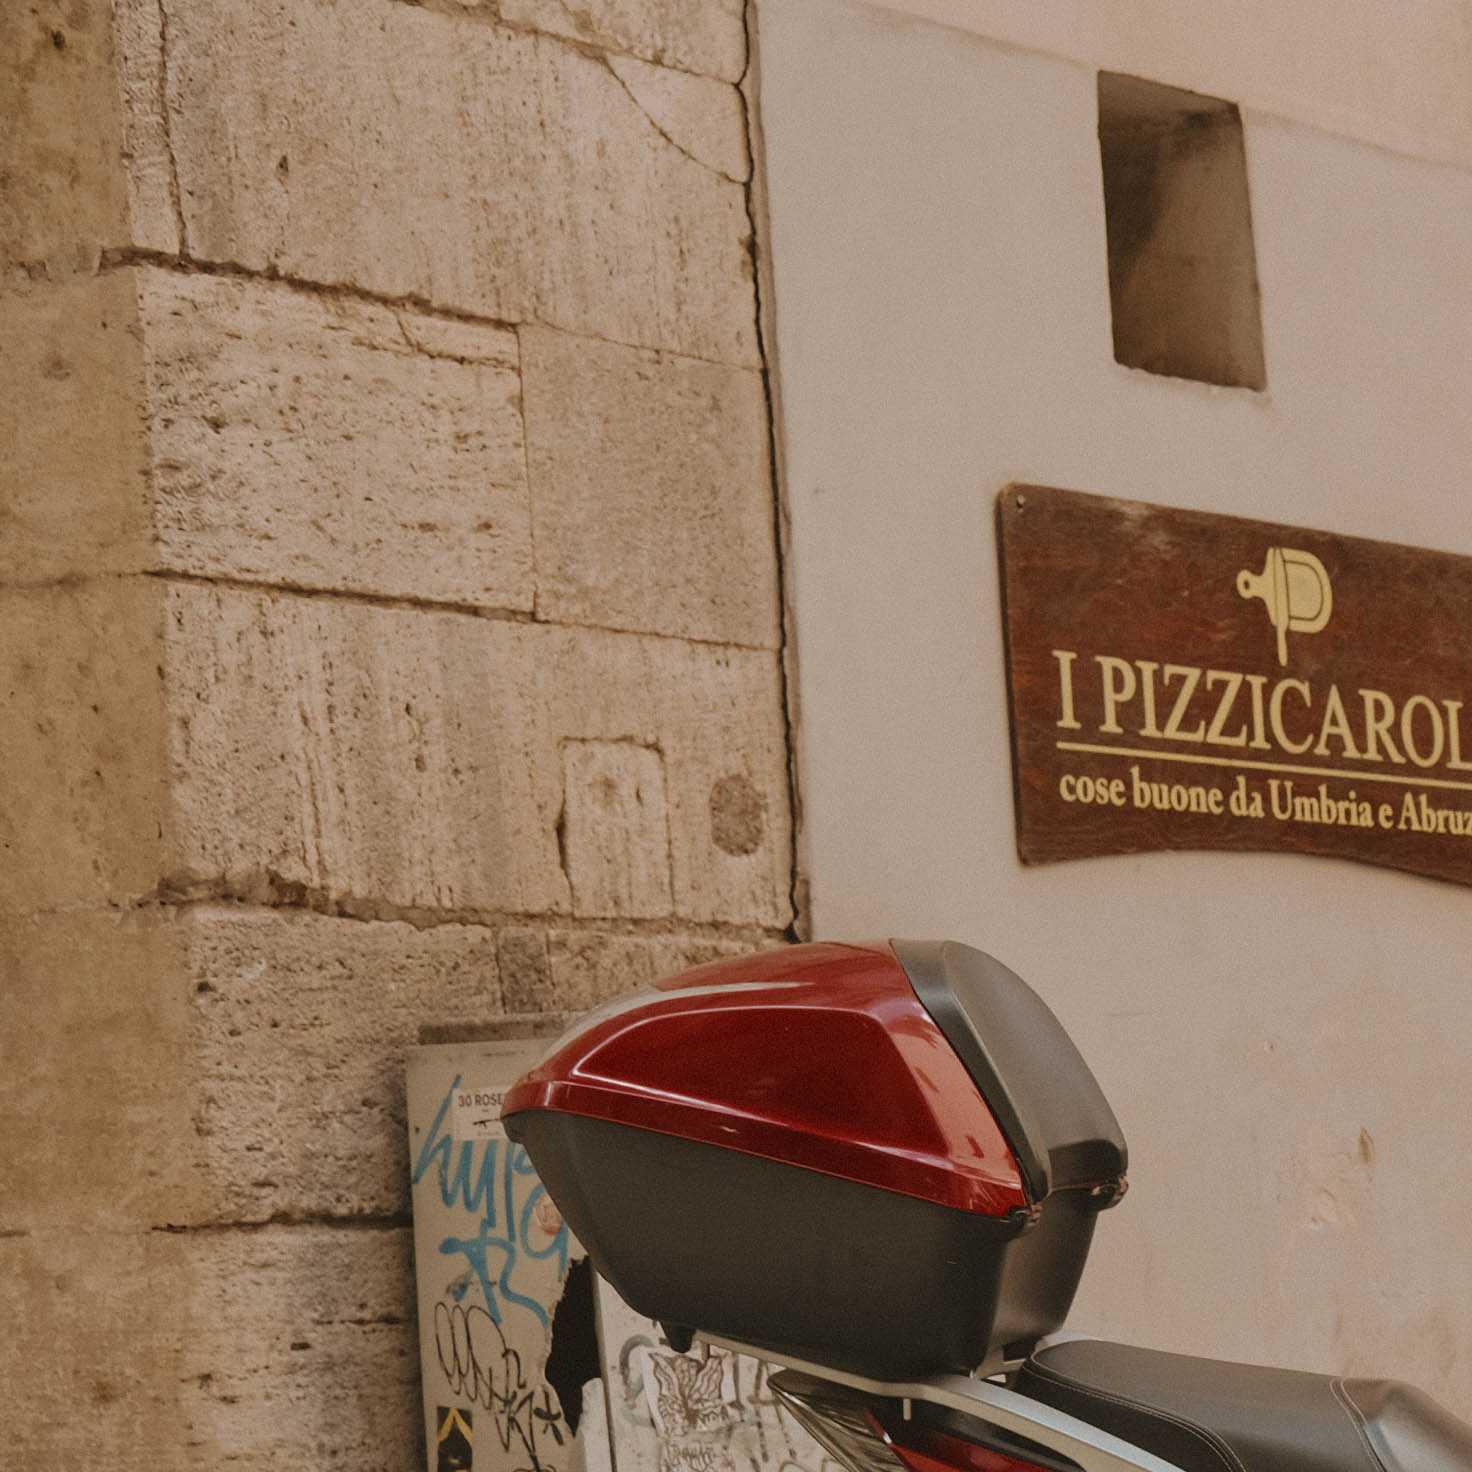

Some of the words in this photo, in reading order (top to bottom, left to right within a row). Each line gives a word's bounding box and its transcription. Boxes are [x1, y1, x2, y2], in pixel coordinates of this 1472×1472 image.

[1052, 649, 1080, 730] I
[1058, 773, 1127, 806] cose
[1131, 765, 1224, 816] buone
[1230, 776, 1265, 819] da
[1269, 778, 1374, 830] Umbria
[1378, 805, 1395, 830] e
